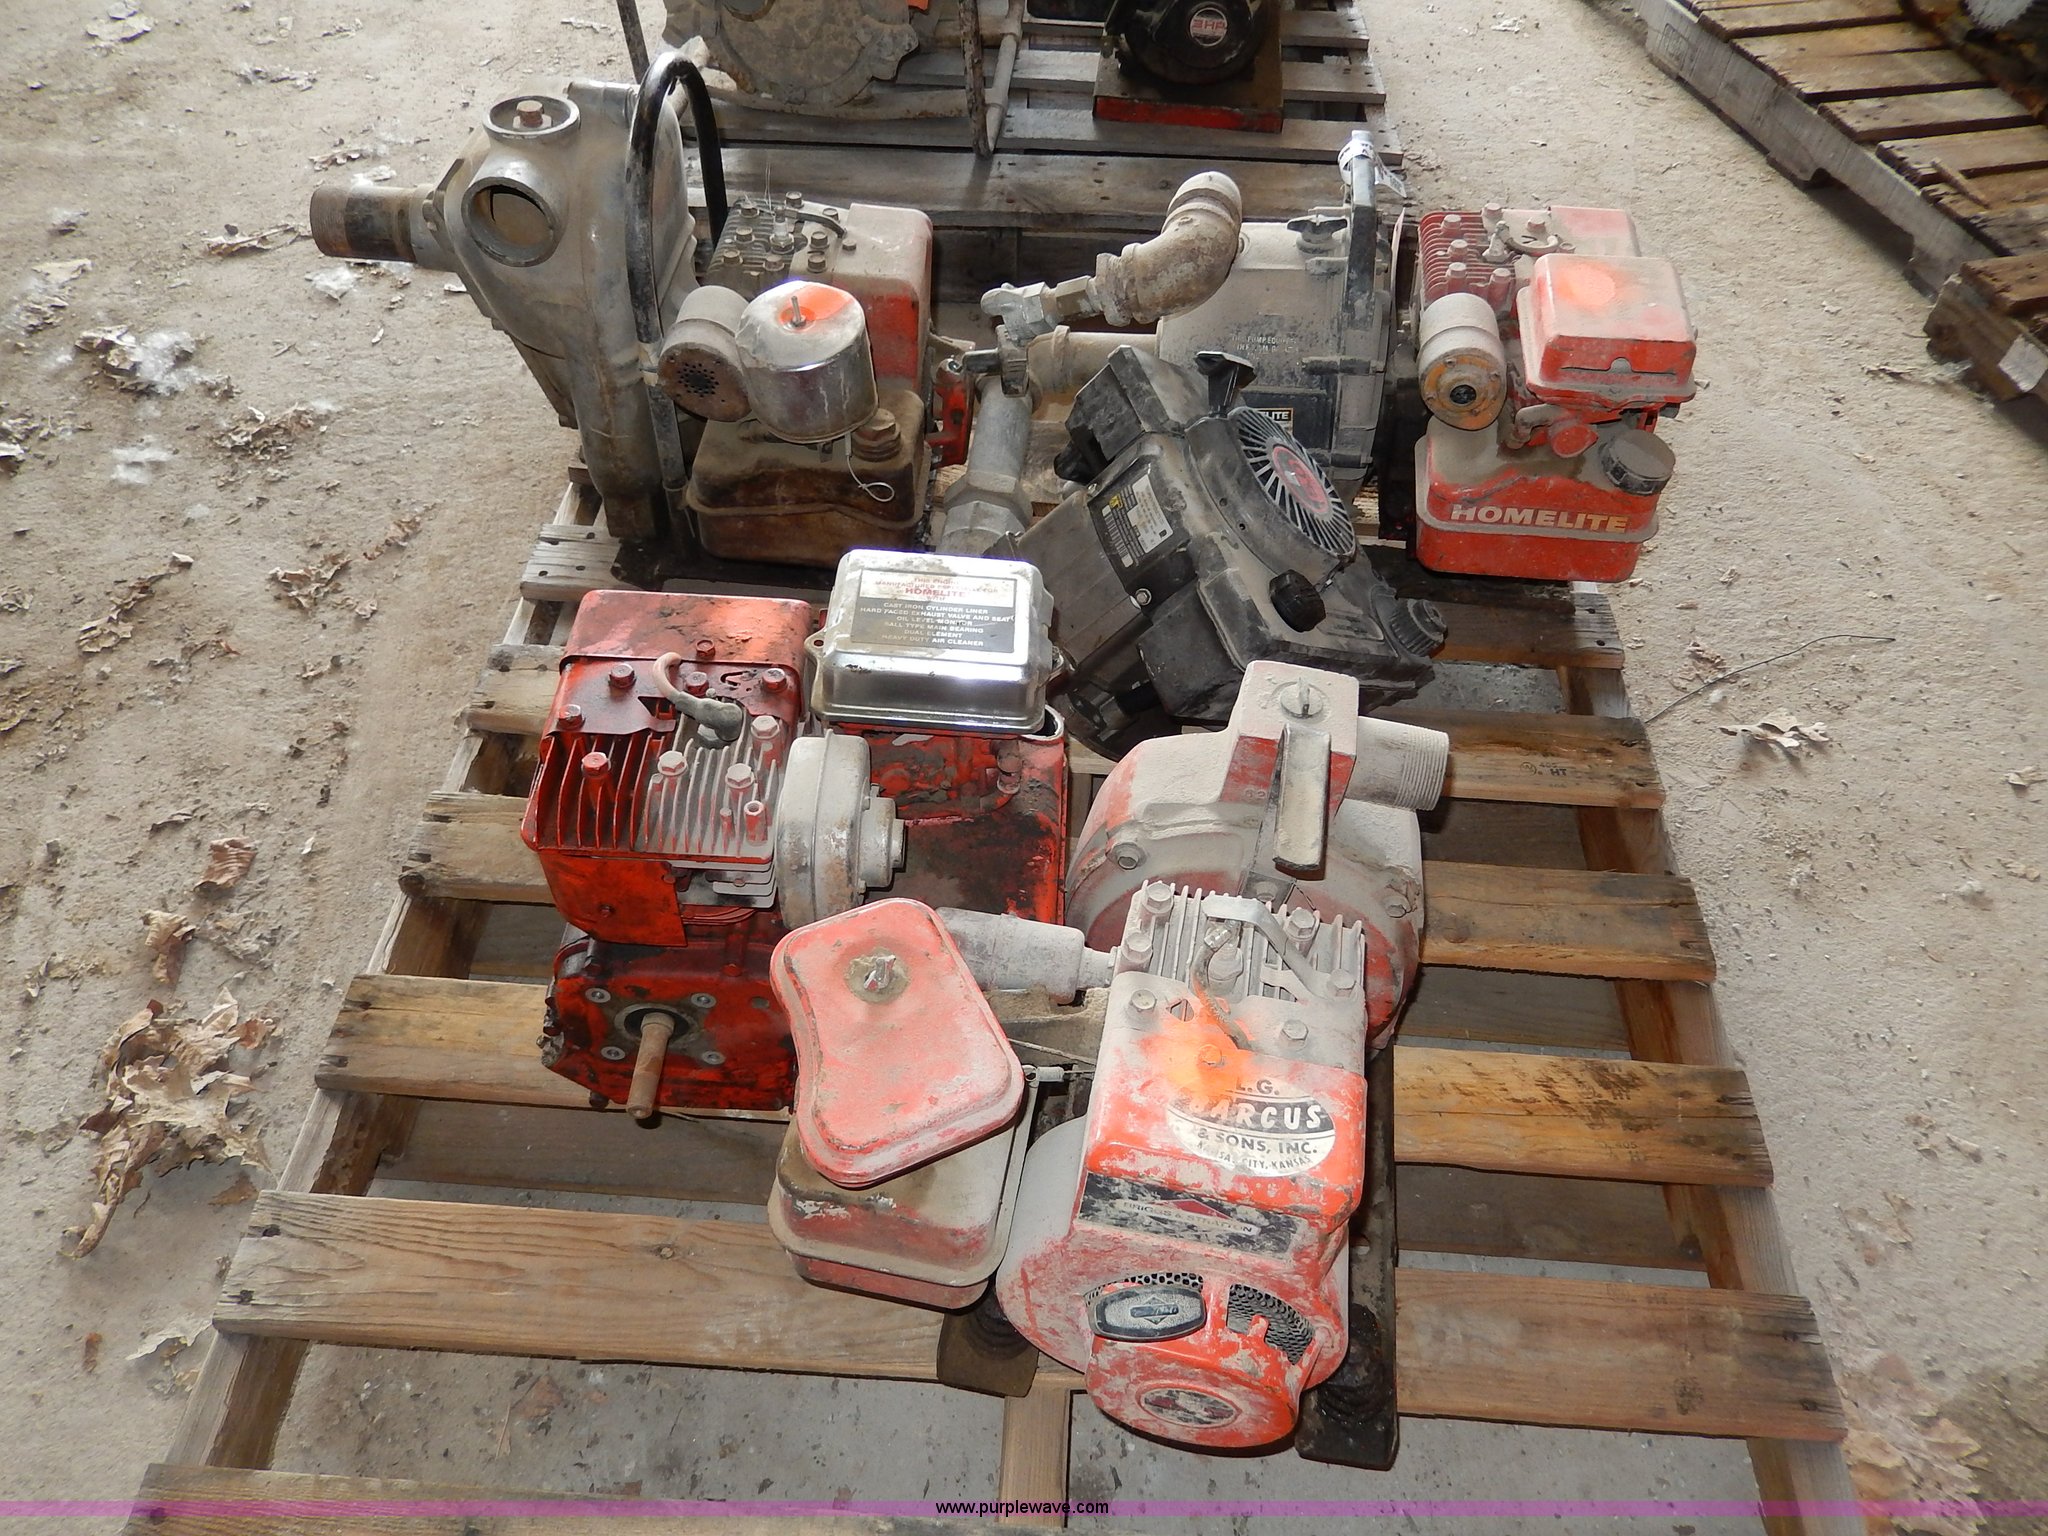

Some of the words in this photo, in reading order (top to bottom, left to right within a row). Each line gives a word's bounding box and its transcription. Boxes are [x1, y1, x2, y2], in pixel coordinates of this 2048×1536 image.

[1450, 504, 1629, 534] HOMELITE
[905, 588, 967, 598] HOMELITE
[926, 605, 964, 613] CYLINDER
[926, 630, 963, 638] ELEMENT
[949, 626, 984, 634] BEARING
[947, 639, 984, 647] CLEANER
[1236, 1077, 1280, 1096] L.G.
[1198, 1128, 1209, 1140] &
[1215, 1132, 1271, 1154] SONS,
[1279, 1141, 1317, 1155] INC.
[1272, 1154, 1313, 1170] KANSAS
